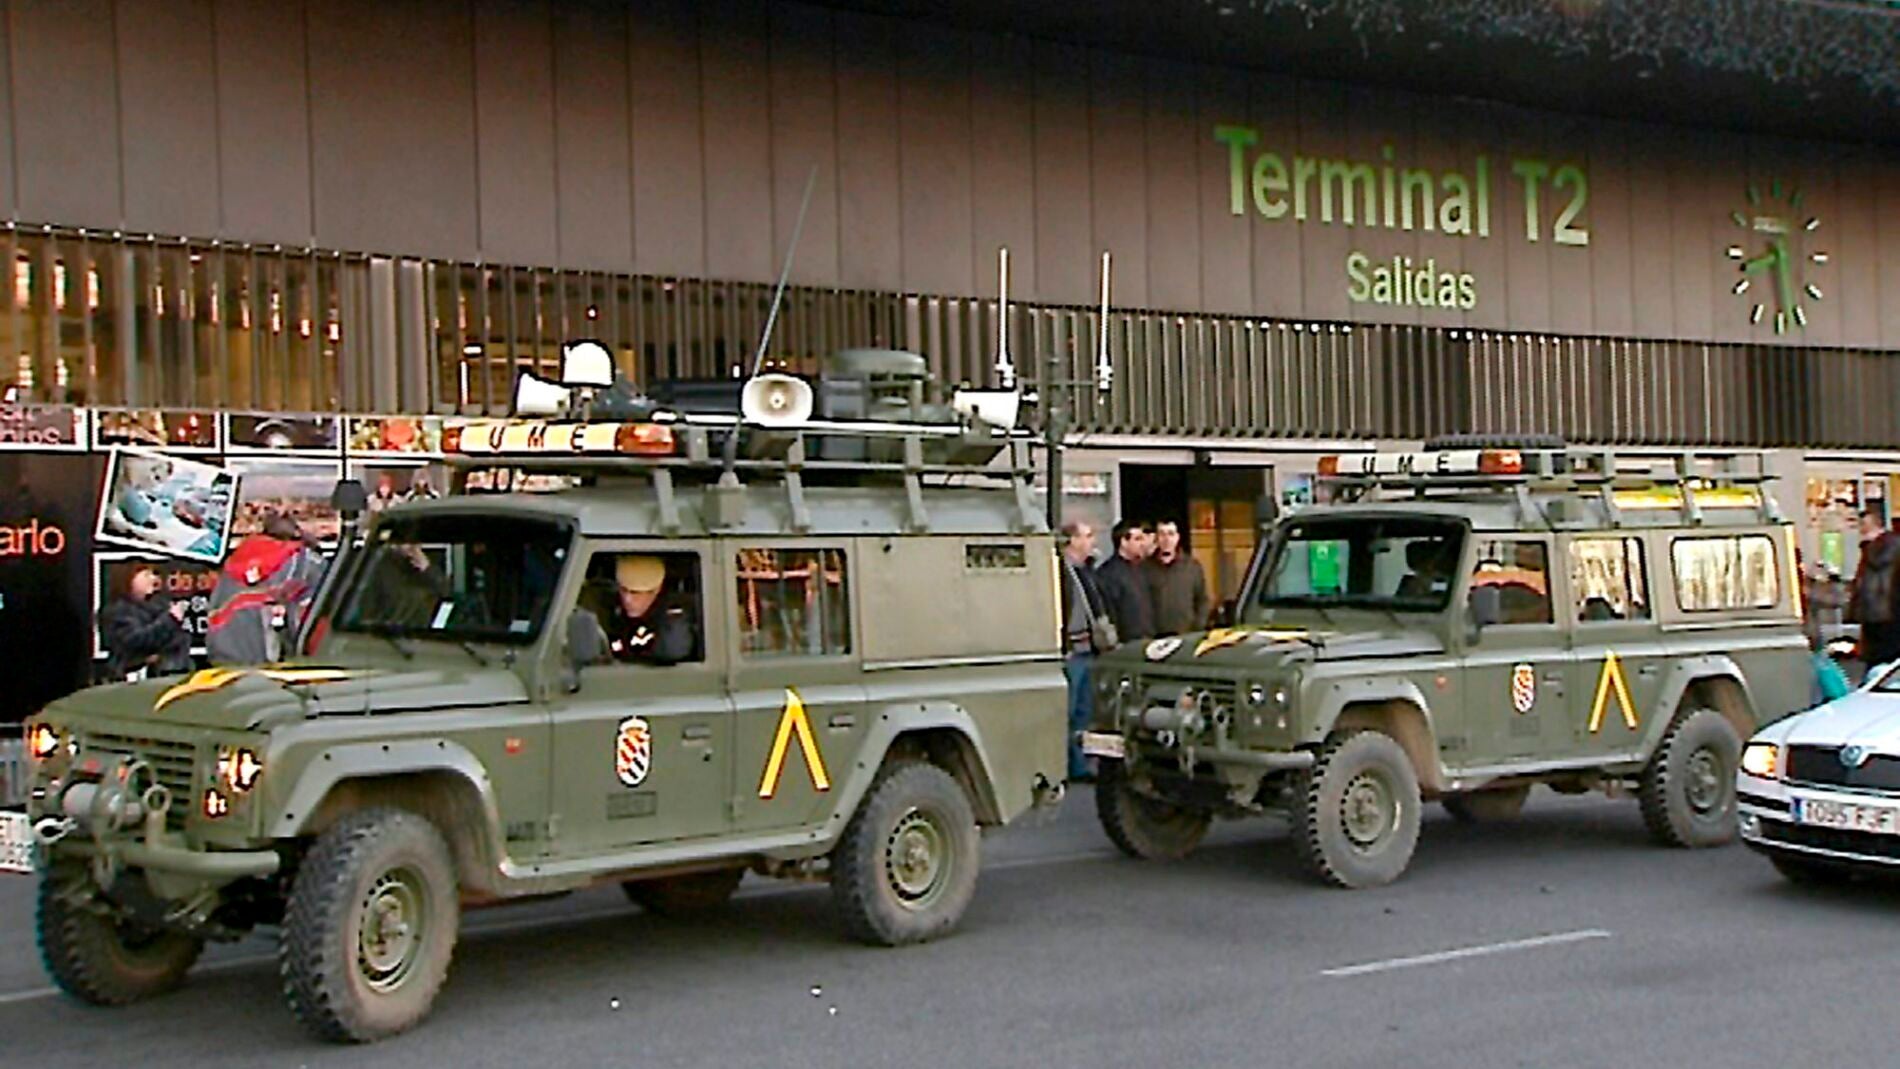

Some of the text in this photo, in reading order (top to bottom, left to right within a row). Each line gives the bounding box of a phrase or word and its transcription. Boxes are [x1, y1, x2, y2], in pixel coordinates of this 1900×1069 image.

[1214, 126, 1590, 246] Terminal T2
[1347, 252, 1476, 310] Salidas
